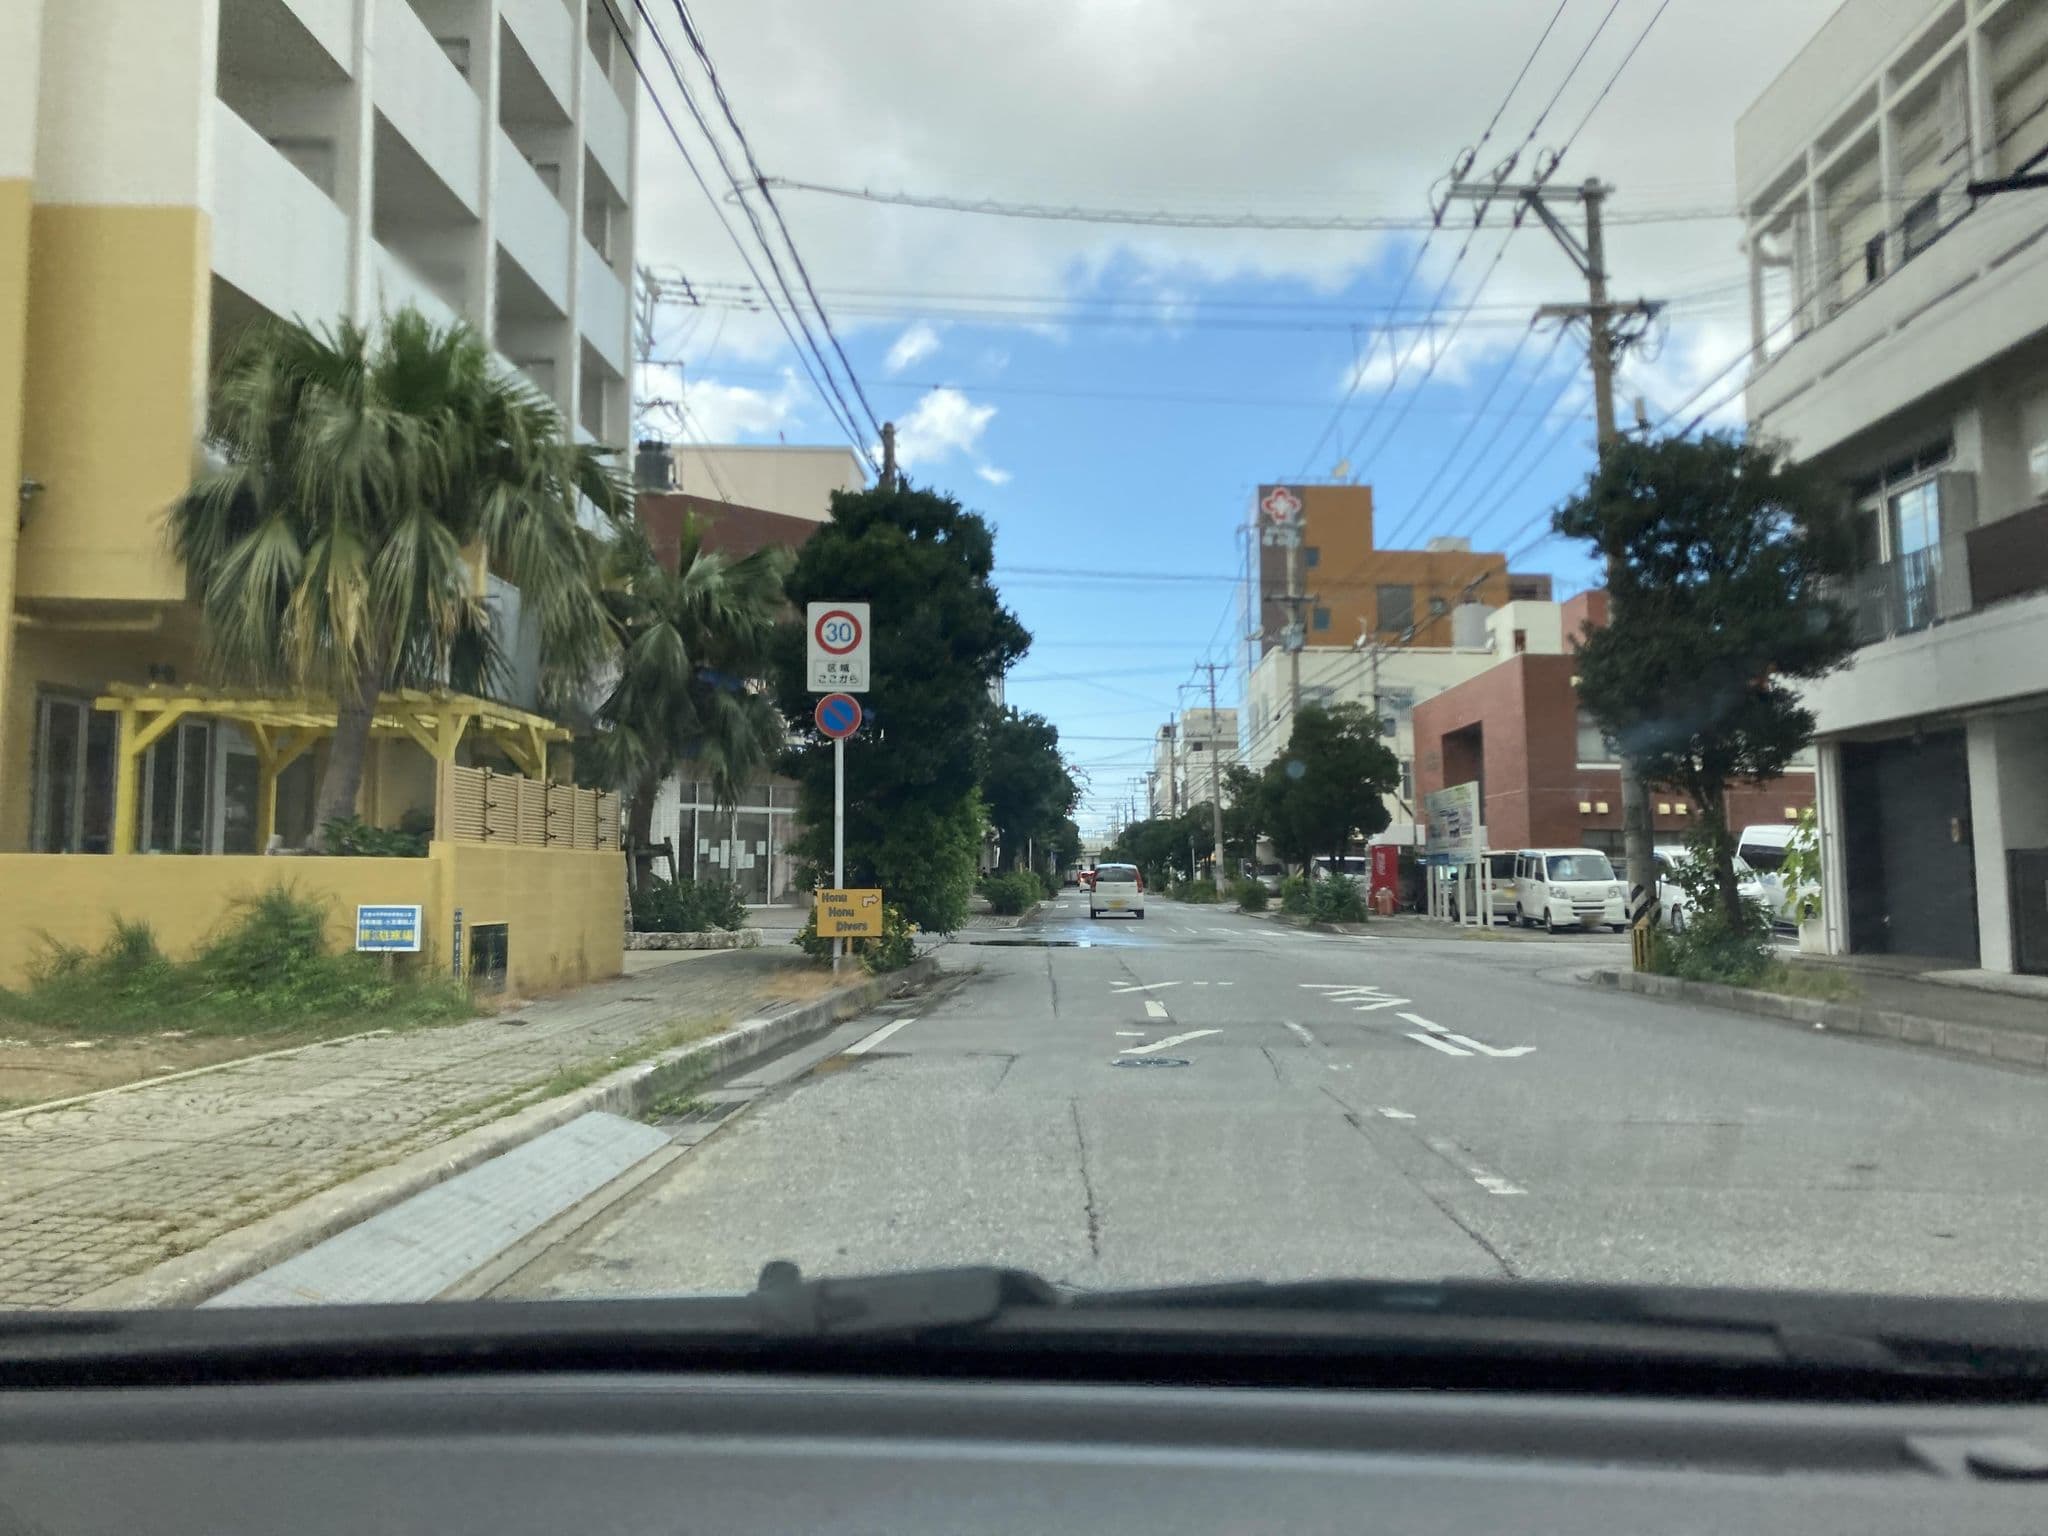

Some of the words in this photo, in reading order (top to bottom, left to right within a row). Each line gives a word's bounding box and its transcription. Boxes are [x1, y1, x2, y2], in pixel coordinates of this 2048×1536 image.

[826, 623, 851, 642] 30
[818, 674, 858, 684] ここから
[822, 893, 847, 903] Honu
[829, 907, 854, 917] Honu
